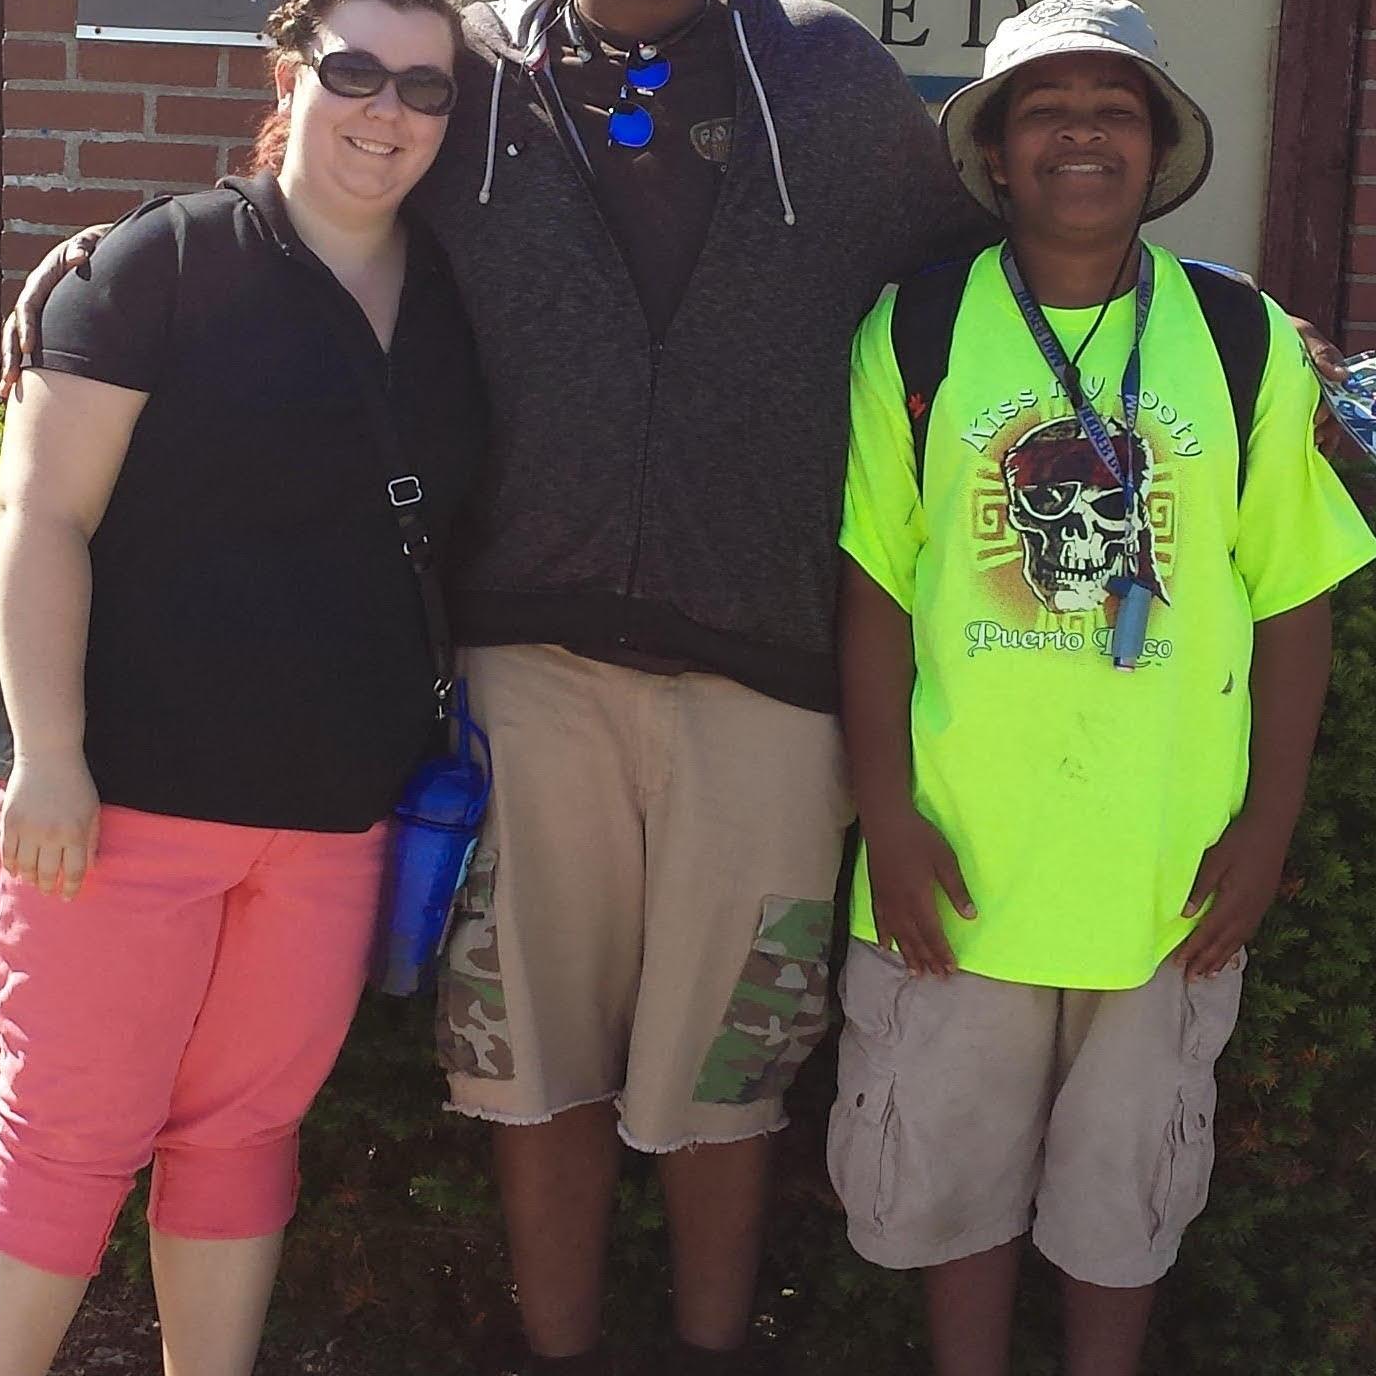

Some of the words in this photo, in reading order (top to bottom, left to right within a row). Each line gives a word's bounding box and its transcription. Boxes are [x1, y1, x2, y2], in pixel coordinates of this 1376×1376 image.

[960, 388, 1039, 453] Kiss
[1117, 390, 1203, 457] ooty
[965, 620, 1085, 658] Puerto
[1092, 627, 1173, 668] co
